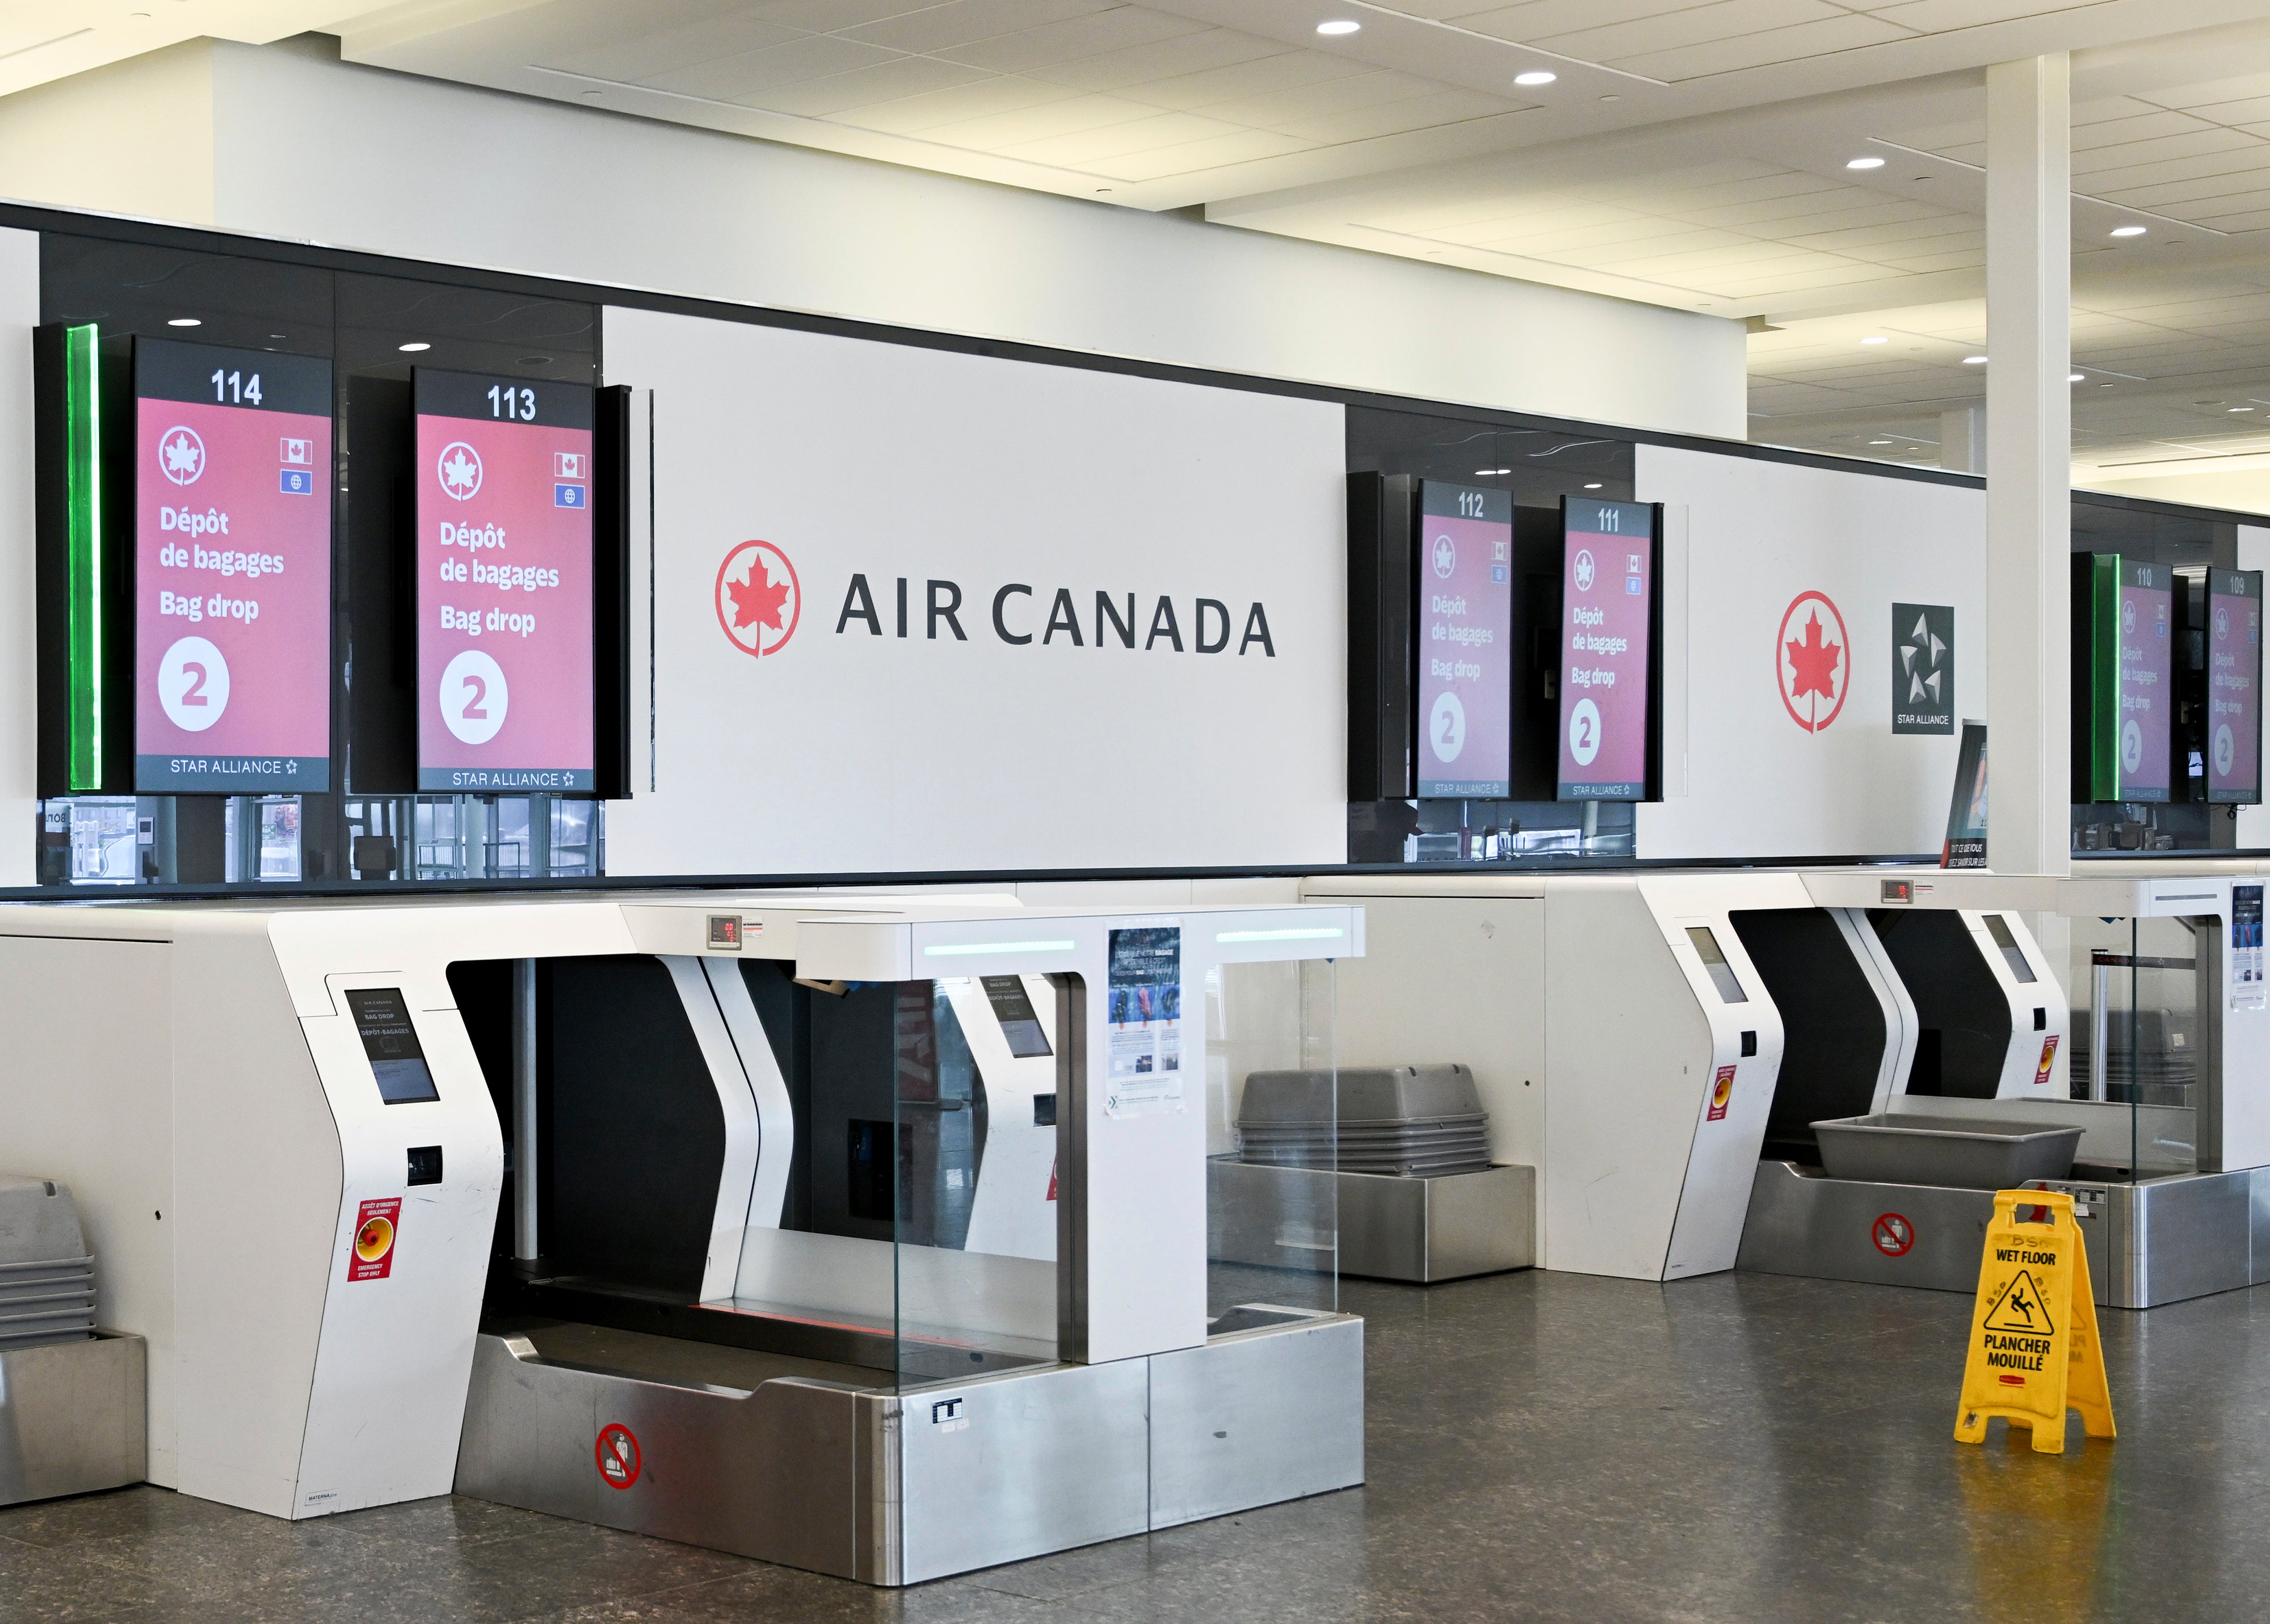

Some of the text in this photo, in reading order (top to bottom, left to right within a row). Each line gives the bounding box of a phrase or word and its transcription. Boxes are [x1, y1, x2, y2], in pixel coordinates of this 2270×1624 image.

[212, 370, 262, 405] 114
[489, 386, 535, 420] 113
[1459, 492, 1483, 517] 112
[161, 507, 228, 538] Dépôt
[1599, 508, 1618, 532] 111
[441, 521, 505, 552] Dépôt
[161, 544, 284, 578] de bagages
[440, 558, 558, 591] de bagages
[2138, 568, 2151, 586] 110
[2230, 577, 2244, 594] 109
[161, 591, 258, 623] Bag drop
[836, 574, 1275, 657] AIR CANADA
[1433, 595, 1466, 617] Dépôt
[442, 606, 535, 637] Bag drop
[1574, 607, 1603, 628] Dépôt
[1432, 622, 1493, 647] de bagages
[1573, 633, 1626, 655] de bagages
[2122, 646, 2142, 662] Dépôt
[1432, 659, 1480, 681] Bag drop
[1572, 667, 1615, 688] Bag drop
[2122, 668, 2132, 680] de
[182, 662, 207, 706] 2
[463, 676, 487, 719] 2
[2122, 694, 2150, 710] Bag drop
[2215, 699, 2227, 715] Bag
[1441, 711, 1454, 744] 2
[1898, 714, 1948, 724] STAR ALLIANCE
[1579, 717, 1590, 747] 2
[2128, 734, 2136, 760] 2
[2220, 737, 2229, 762] 2
[171, 760, 280, 773] STAR ALLIANCE
[453, 773, 558, 785] STAR ALLIANCE
[1435, 784, 1491, 794] STAR ALLIANCE
[1573, 786, 1622, 795] STAR ALLIANCE
[1968, 857, 1978, 866] SUR
[1997, 1249, 2055, 1265] WET FLOOR
[1985, 1334, 2051, 1354] PLANCHER
[1987, 1352, 2043, 1371] MOUILLÉ
